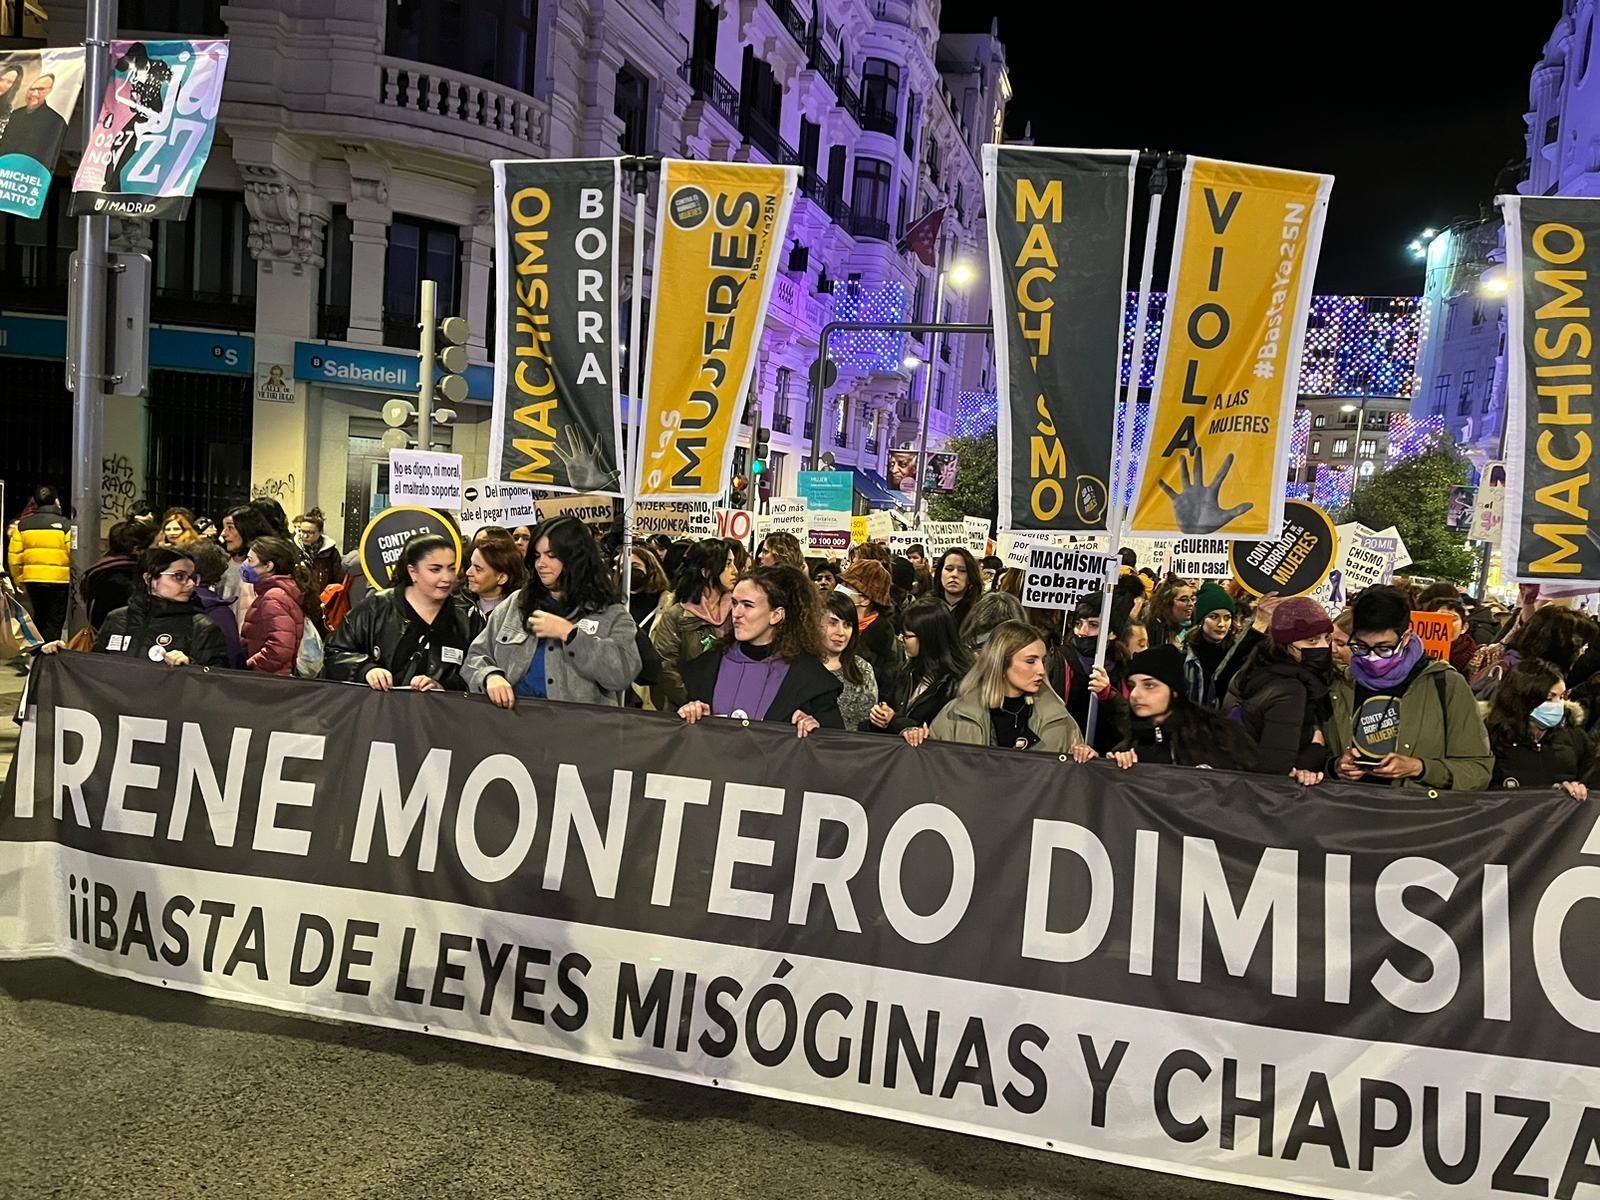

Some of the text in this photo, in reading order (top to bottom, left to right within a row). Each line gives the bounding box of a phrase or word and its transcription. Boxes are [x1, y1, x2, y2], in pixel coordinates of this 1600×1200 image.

[0, 169, 42, 187] MICHEL
[0, 192, 37, 207] ATITO
[30, 187, 40, 197] &
[109, 202, 156, 213] MADRID
[575, 188, 607, 386] BORRA
[1253, 202, 1306, 380] #BastaYa25N
[1161, 187, 1243, 458] VIOLA
[510, 187, 558, 483] MACHISMO
[670, 190, 761, 488] MUJERES
[224, 348, 238, 365] S
[1015, 178, 1067, 522] MACHSMO
[323, 360, 407, 384] Sabadell
[1213, 389, 1249, 410] A LAS
[1528, 222, 1593, 573] MACHISMO
[1208, 415, 1270, 435] MUJERES
[394, 461, 460, 479] No es digno, ni moral,
[395, 481, 460, 499] el maltrato soportar.
[485, 486, 498, 498] Del
[461, 505, 533, 522] sale el pegar y matar.
[788, 504, 804, 512] más
[715, 511, 750, 540] NO
[773, 516, 804, 524] muertes
[832, 538, 846, 546] 009
[1174, 539, 1228, 555] ¿GUERRA?
[1259, 532, 1296, 575] BORRADO
[1272, 532, 1318, 586] MUJERES
[1348, 546, 1384, 569] CHISMO,
[1188, 561, 1199, 574] en
[1202, 561, 1229, 574] casa!
[1346, 557, 1380, 577] barde
[1026, 588, 1082, 604] terroris
[14, 704, 326, 857] IRENE
[350, 741, 976, 945] MONTERO
[289, 914, 379, 996] DE
[394, 927, 592, 1033] LEYES
[612, 958, 1050, 1115] MISÓGINAS
[1077, 1033, 1130, 1128] Y
